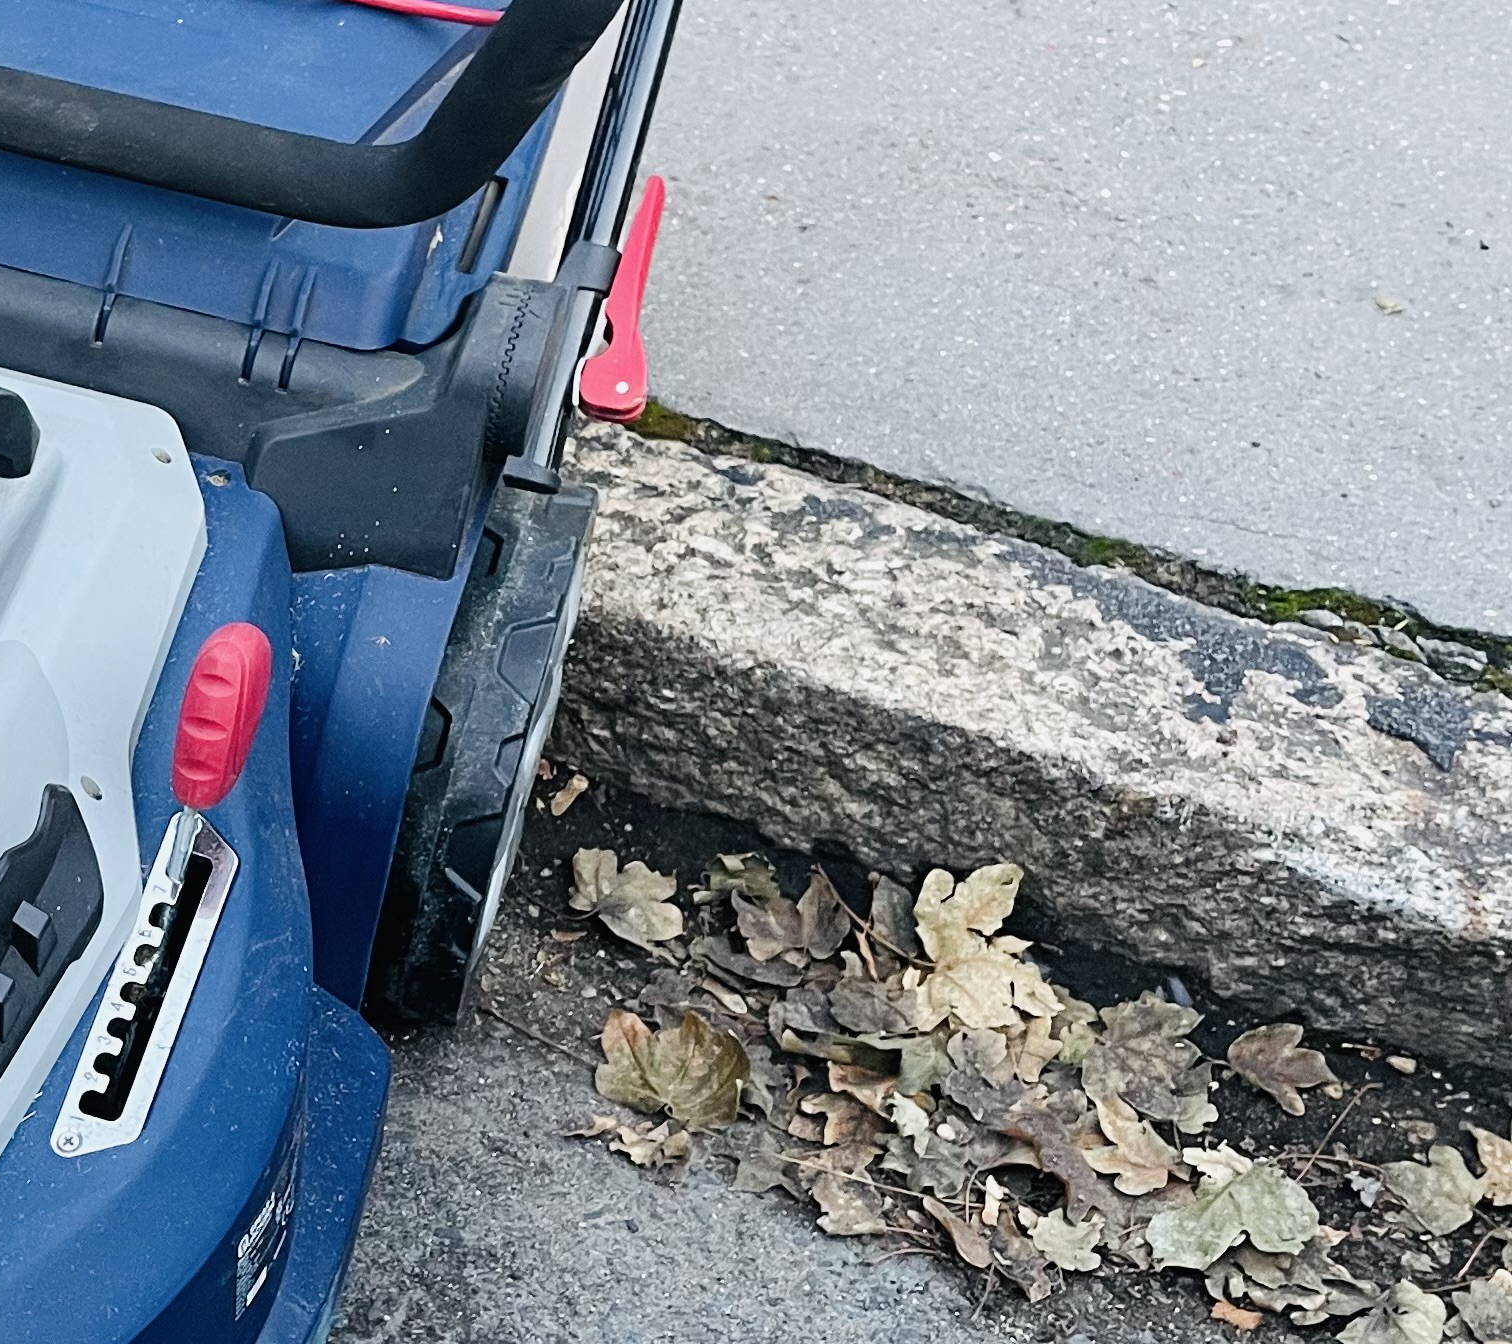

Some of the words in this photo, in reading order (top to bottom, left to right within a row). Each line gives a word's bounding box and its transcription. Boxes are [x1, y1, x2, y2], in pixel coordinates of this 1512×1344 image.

[84, 1072, 98, 1082] 2
[98, 1036, 111, 1045] 3
[111, 1001, 124, 1011] 4
[152, 885, 167, 893] 7
